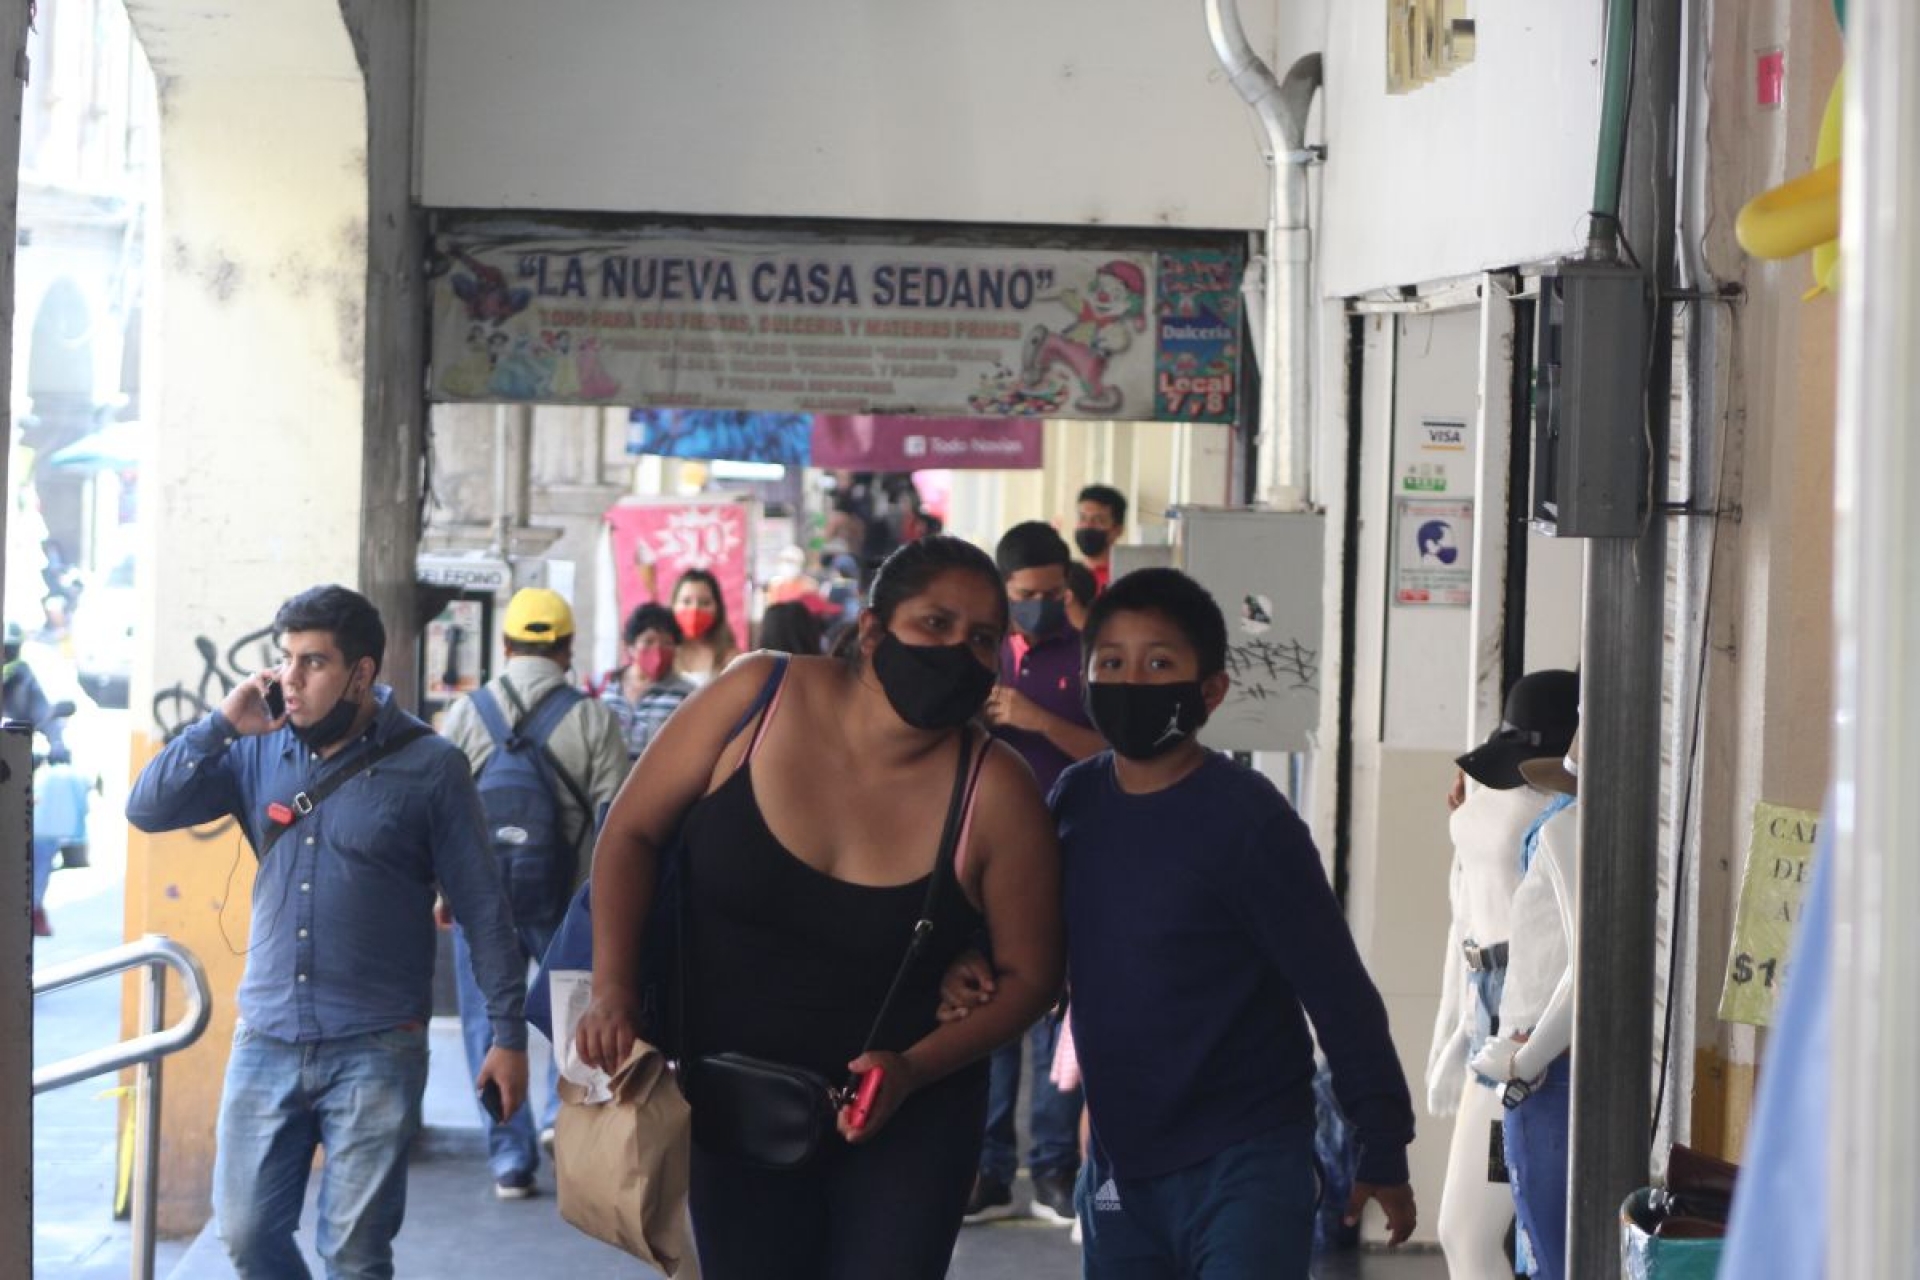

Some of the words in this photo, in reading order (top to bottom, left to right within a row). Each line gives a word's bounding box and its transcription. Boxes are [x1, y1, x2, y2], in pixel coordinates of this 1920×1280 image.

[602, 255, 738, 301] NUEVA
[751, 260, 858, 306] CASA
[847, 317, 862, 337] Y
[1159, 371, 1233, 394] Local
[1165, 392, 1181, 413] 7
[1206, 392, 1225, 414] 8
[1429, 429, 1461, 443] VISA
[1732, 953, 1788, 988] $1
